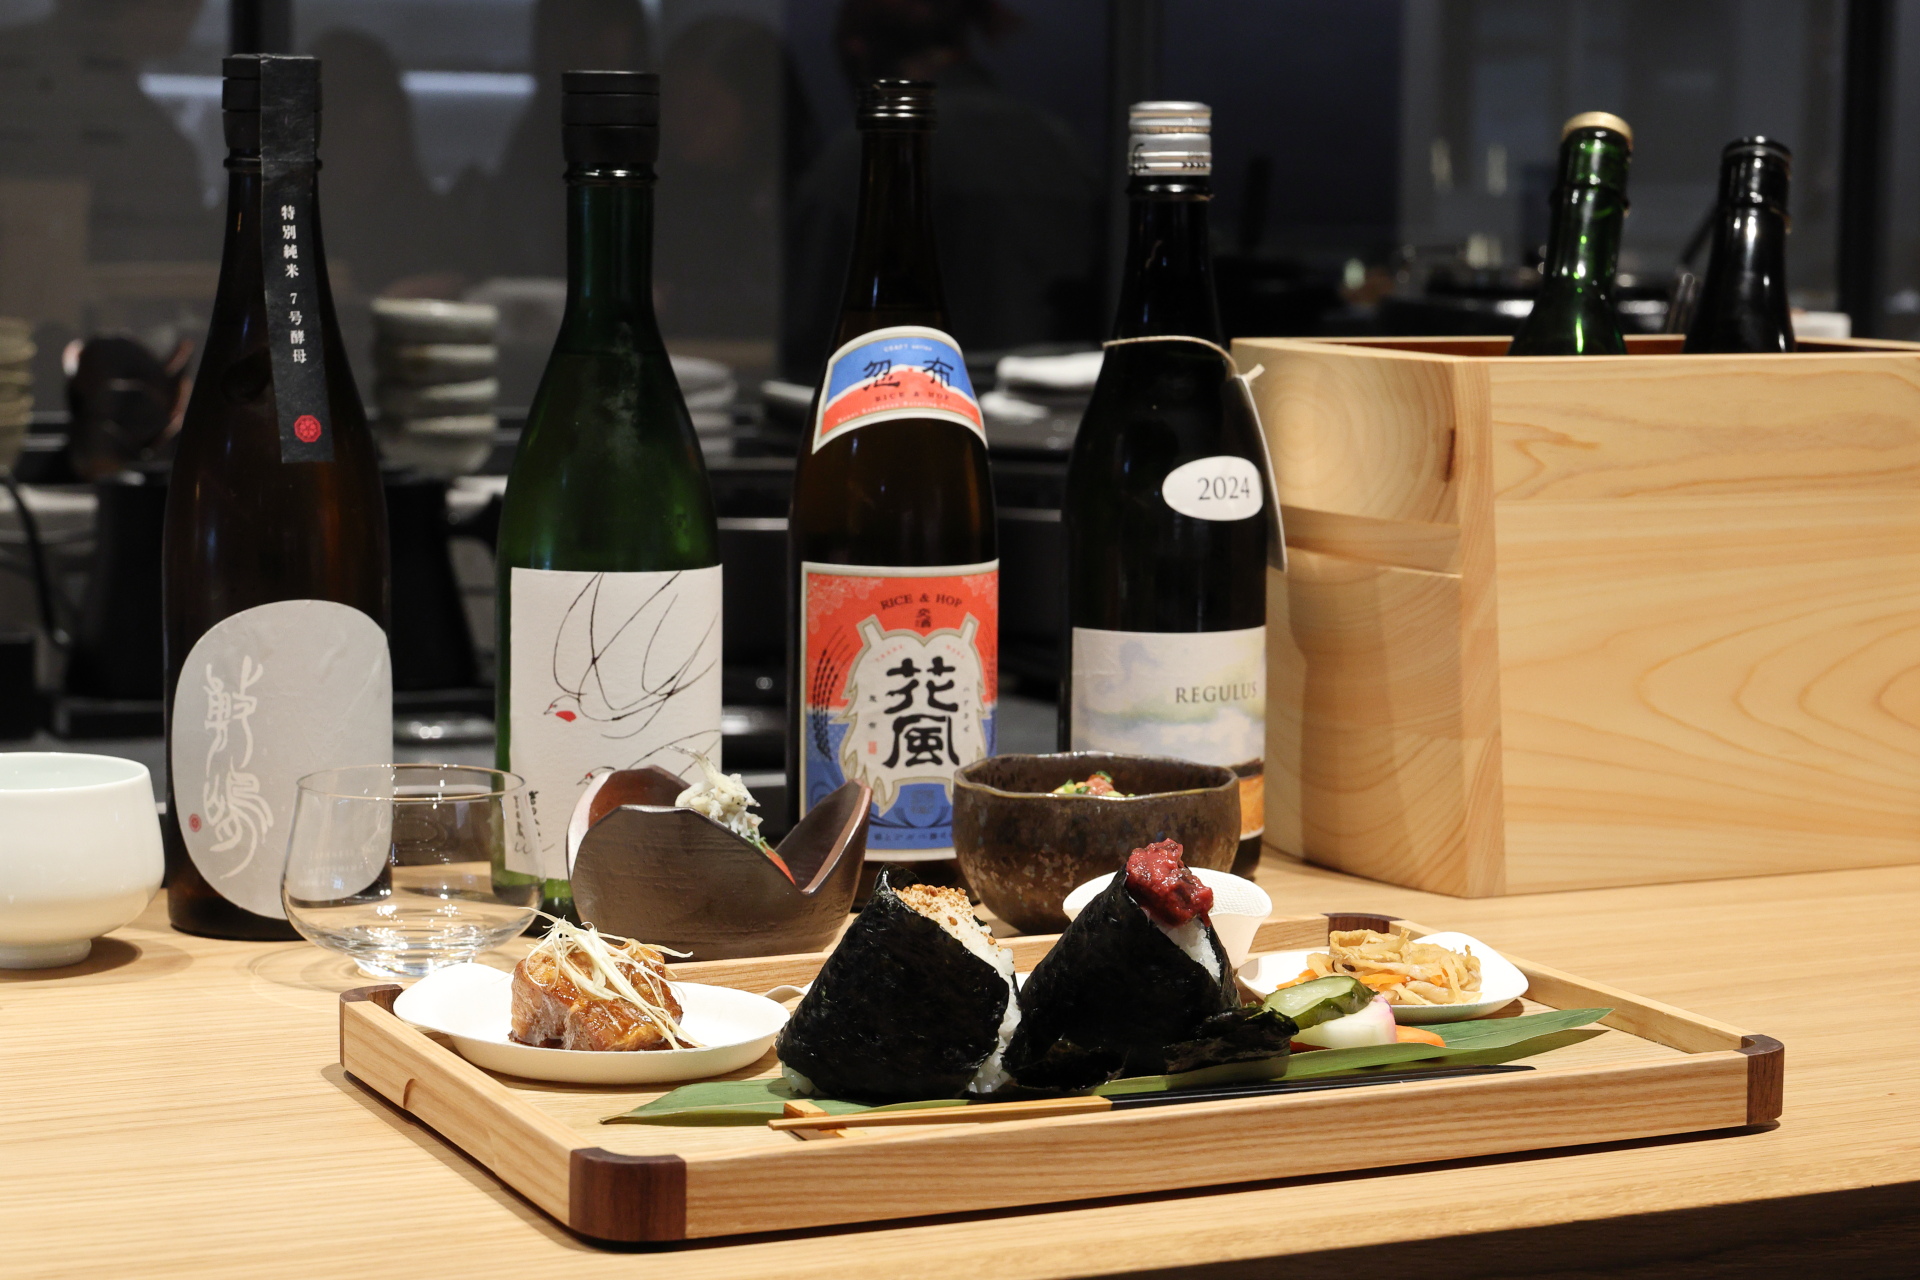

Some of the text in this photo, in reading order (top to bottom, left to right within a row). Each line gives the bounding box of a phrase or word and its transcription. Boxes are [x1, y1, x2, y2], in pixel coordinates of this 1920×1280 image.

[280, 204, 308, 364] 特別純米 7号酵母
[874, 392, 906, 402] RICE
[1197, 476, 1250, 501] 2024
[880, 593, 963, 610] RICE & HOP
[1175, 681, 1258, 704] REGULUS
[882, 655, 960, 770] 花風
